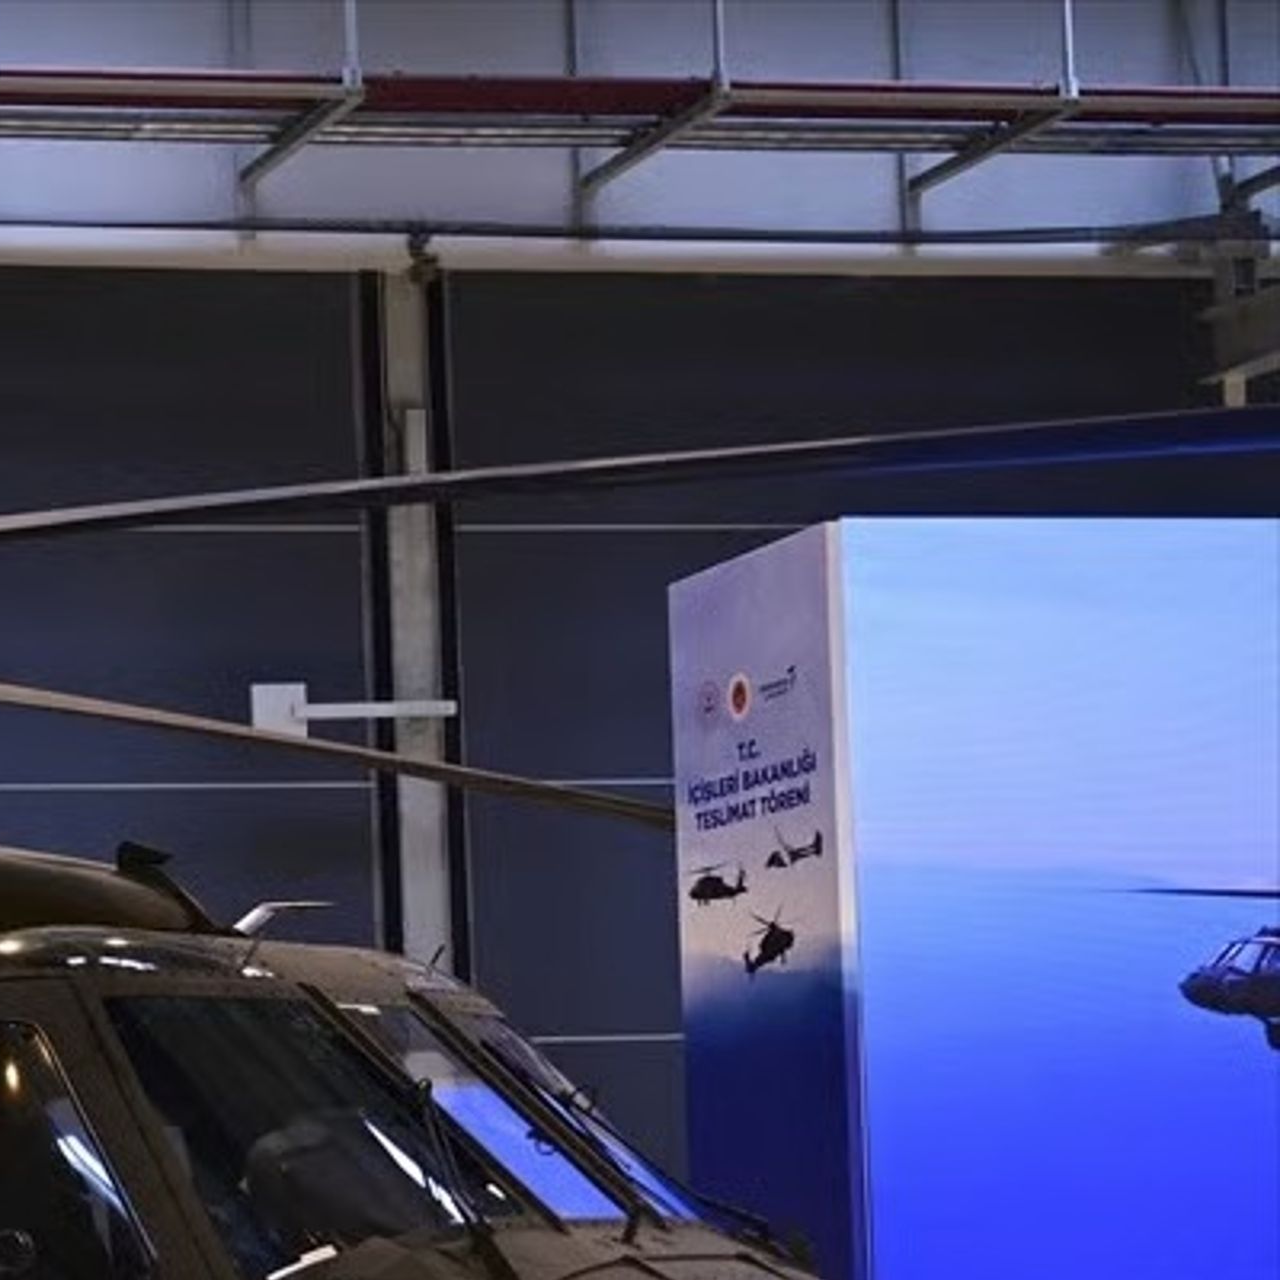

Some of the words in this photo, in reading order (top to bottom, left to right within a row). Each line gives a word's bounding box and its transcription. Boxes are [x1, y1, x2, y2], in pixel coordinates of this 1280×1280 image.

[737, 738, 761, 762] T.C.
[688, 768, 740, 806] İÇİŞLERİ
[742, 747, 817, 791] BAKANLIĞI
[696, 798, 757, 831] TESLİMAT
[760, 779, 811, 815] TÖRENİ
